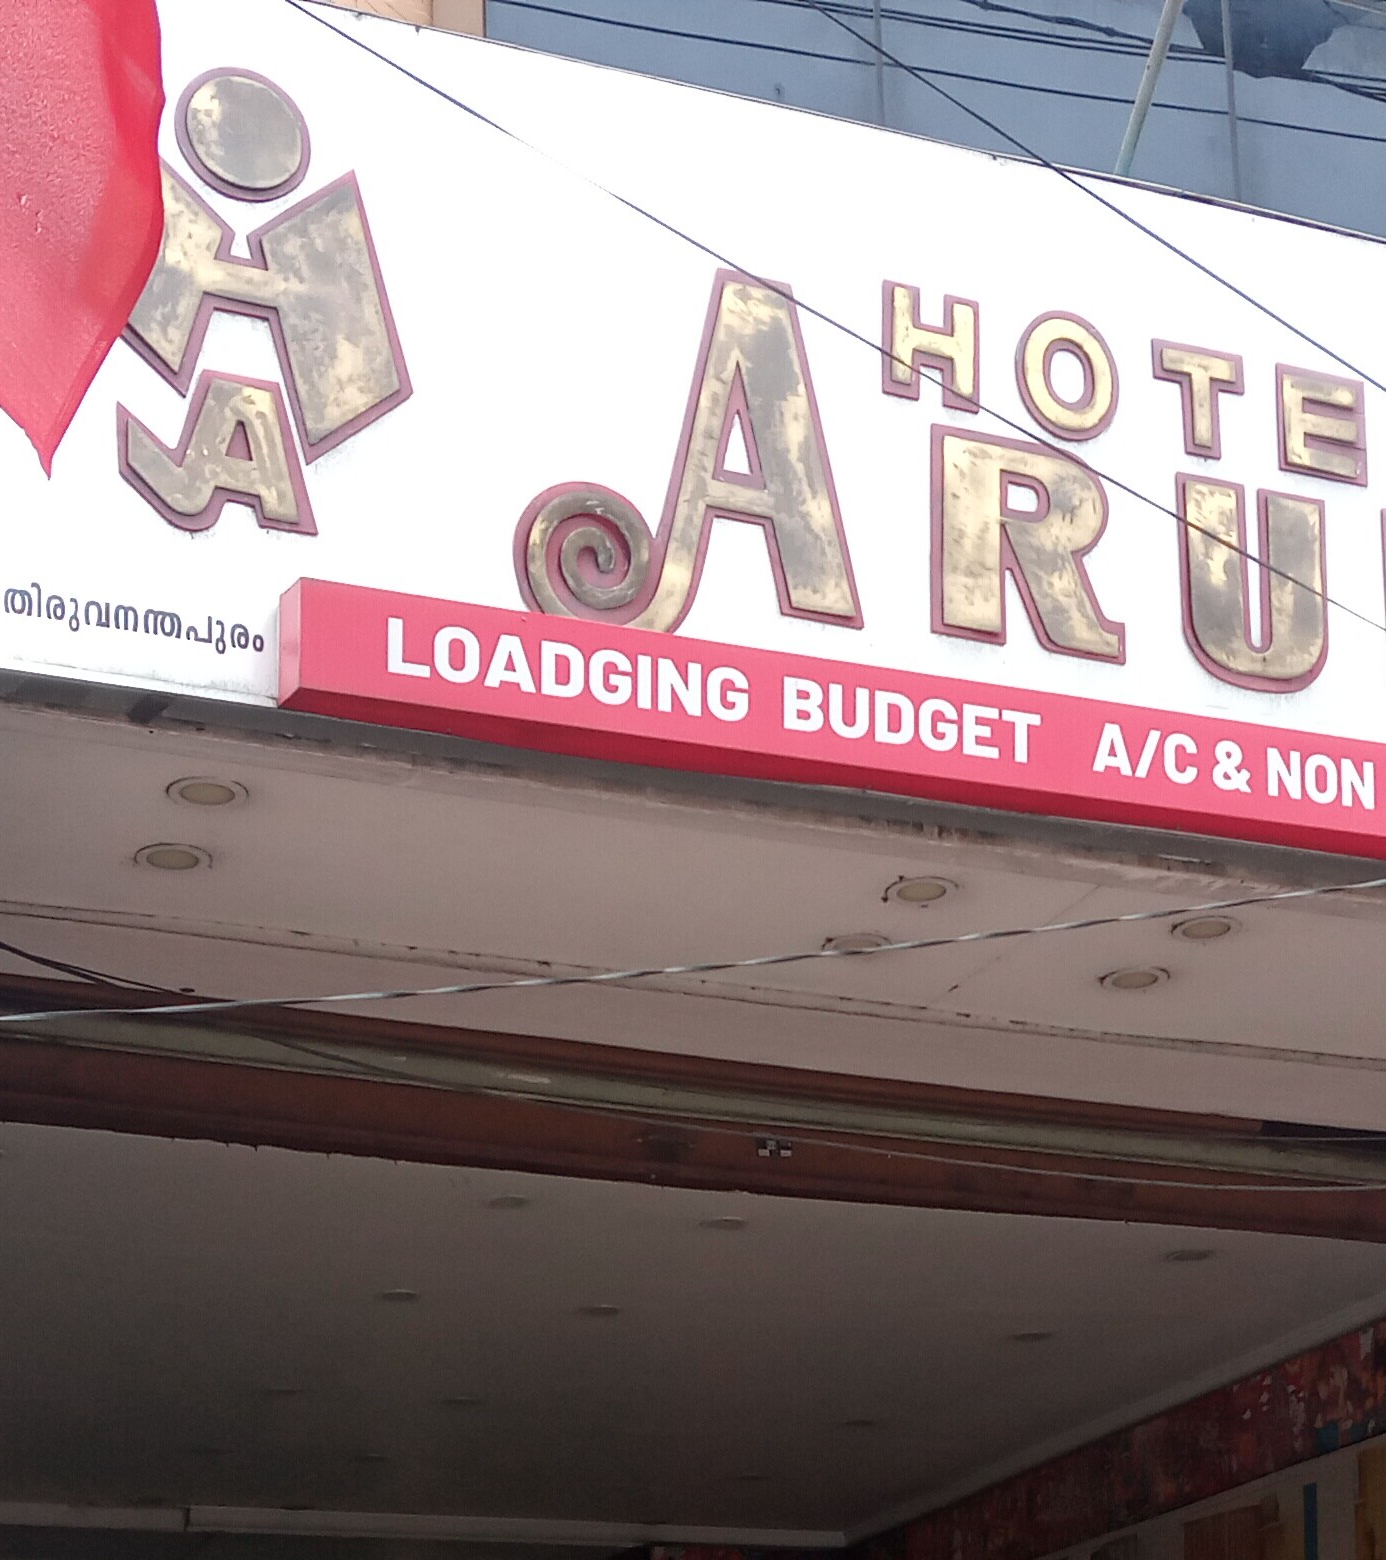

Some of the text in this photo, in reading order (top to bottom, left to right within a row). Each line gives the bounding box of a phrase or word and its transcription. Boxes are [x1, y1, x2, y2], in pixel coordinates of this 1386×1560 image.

[3, 582, 264, 655] തിരുവനന്തപുരം
[387, 617, 750, 722] LOADGING
[782, 676, 1042, 764] BUDGET
[1092, 722, 1198, 785] A/C
[1212, 746, 1252, 794] &
[1267, 747, 1376, 810] NON
